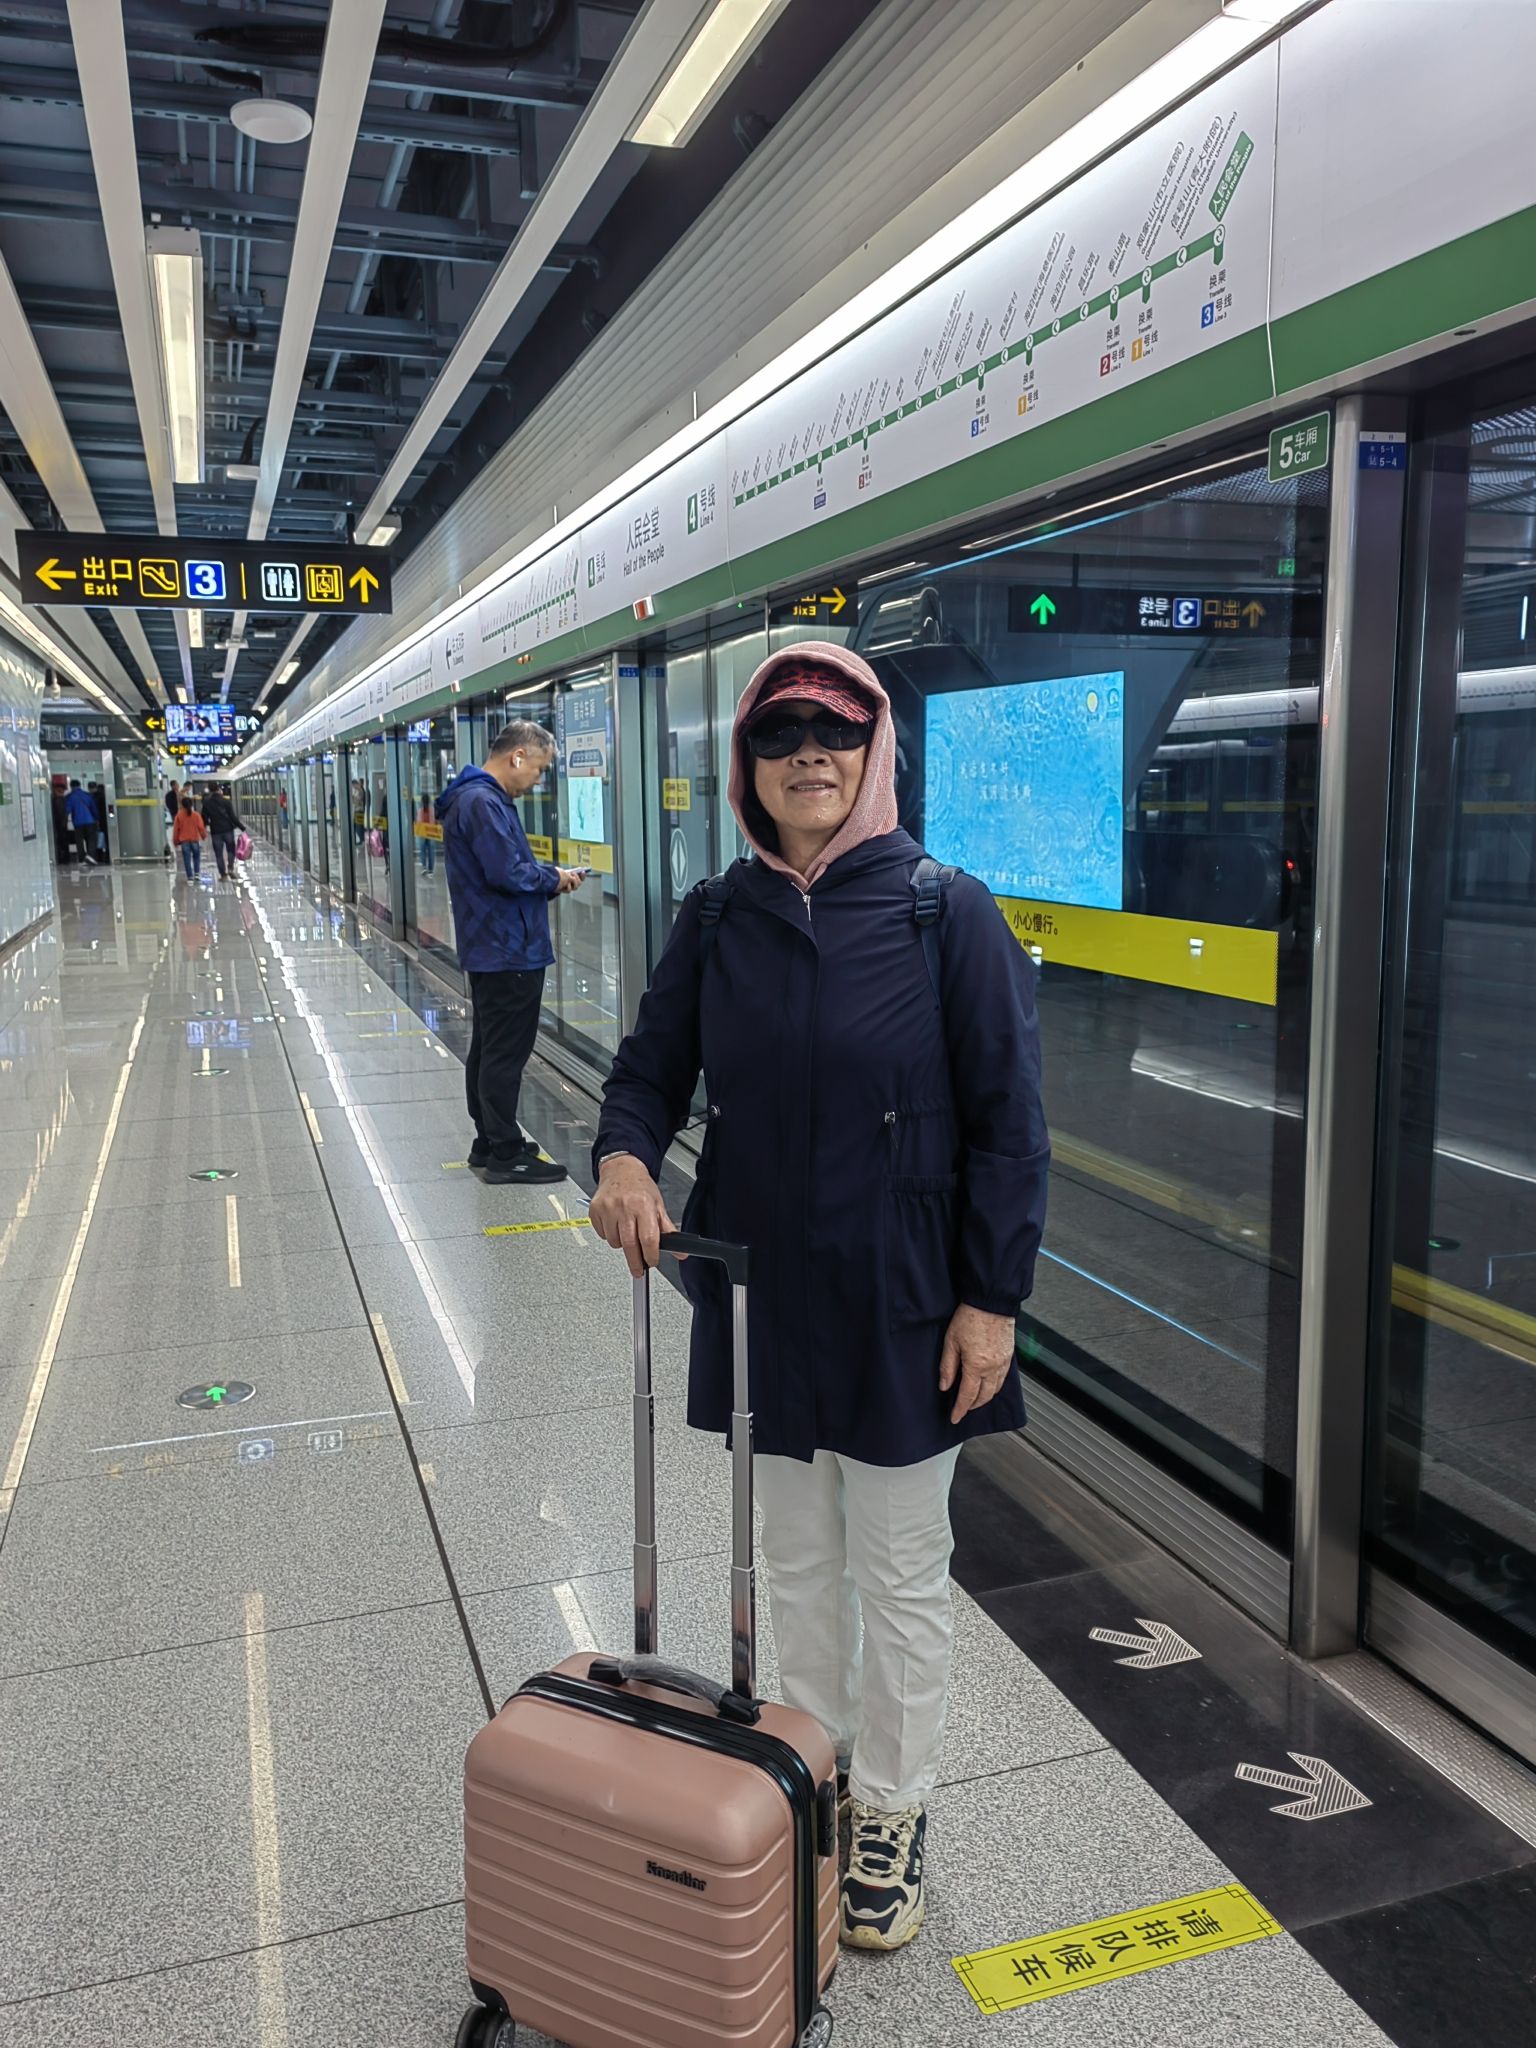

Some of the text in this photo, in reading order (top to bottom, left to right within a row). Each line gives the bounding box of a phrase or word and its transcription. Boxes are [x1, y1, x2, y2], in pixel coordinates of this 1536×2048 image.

[1212, 150, 1240, 213] 人民会堂
[1216, 201, 1227, 219] Hall
[1236, 143, 1253, 174] People
[1209, 269, 1226, 289] 换乘
[1216, 293, 1232, 312] 号线
[1294, 425, 1318, 449] 车厢
[1280, 435, 1294, 469] 5
[1294, 450, 1311, 465] Car
[700, 483, 716, 512] 号线
[626, 505, 660, 554] 人民会堂
[700, 515, 710, 528] Line
[83, 556, 133, 581] 出口
[623, 543, 665, 577] Hall of the People
[84, 583, 118, 597] Exit
[194, 565, 216, 595] 3
[70, 727, 81, 740] 3
[1013, 910, 1058, 936] 小心慢行。
[1011, 1907, 1225, 1986] 请排队候车
